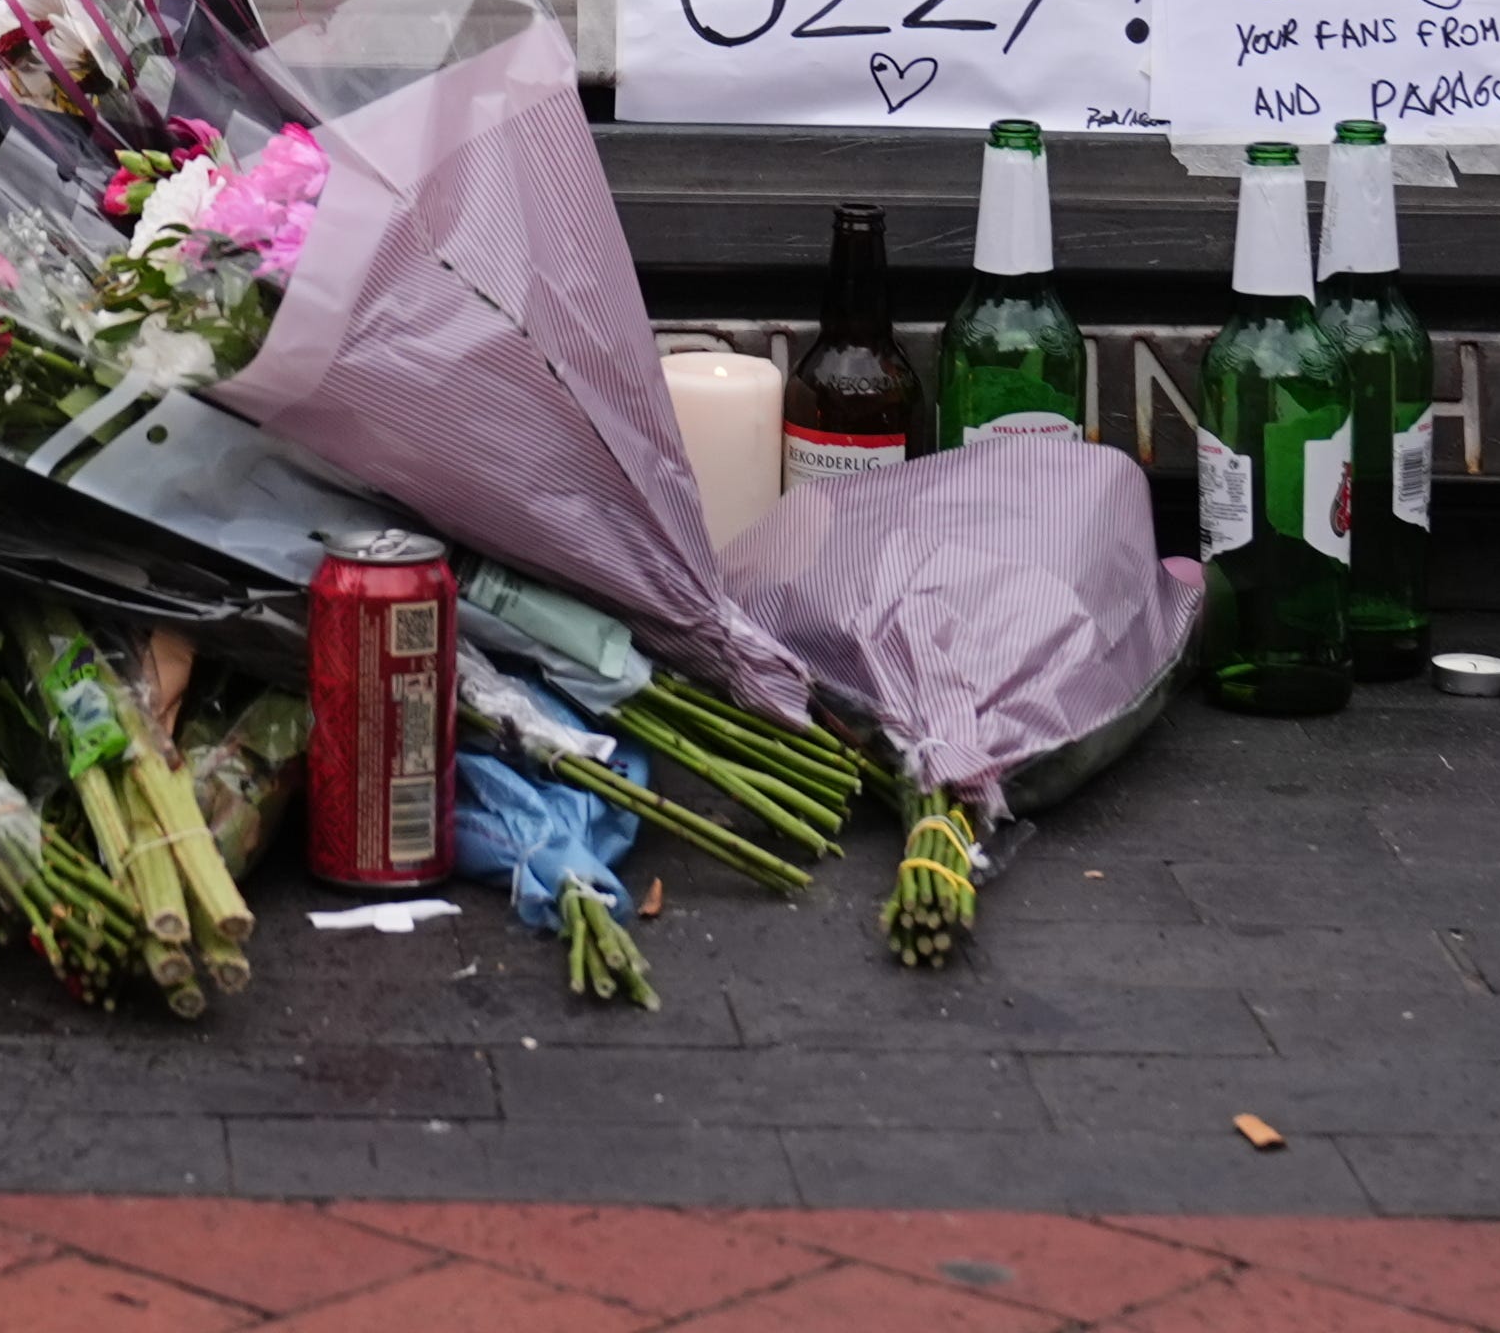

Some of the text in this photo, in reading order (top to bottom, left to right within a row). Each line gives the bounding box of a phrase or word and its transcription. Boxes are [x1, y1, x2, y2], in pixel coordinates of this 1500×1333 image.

[1314, 16, 1398, 51] FANS
[1416, 15, 1500, 50] FROM
[1254, 83, 1321, 123] AND
[991, 424, 1028, 434] STELLA
[788, 444, 883, 471] REKORDERLIG
